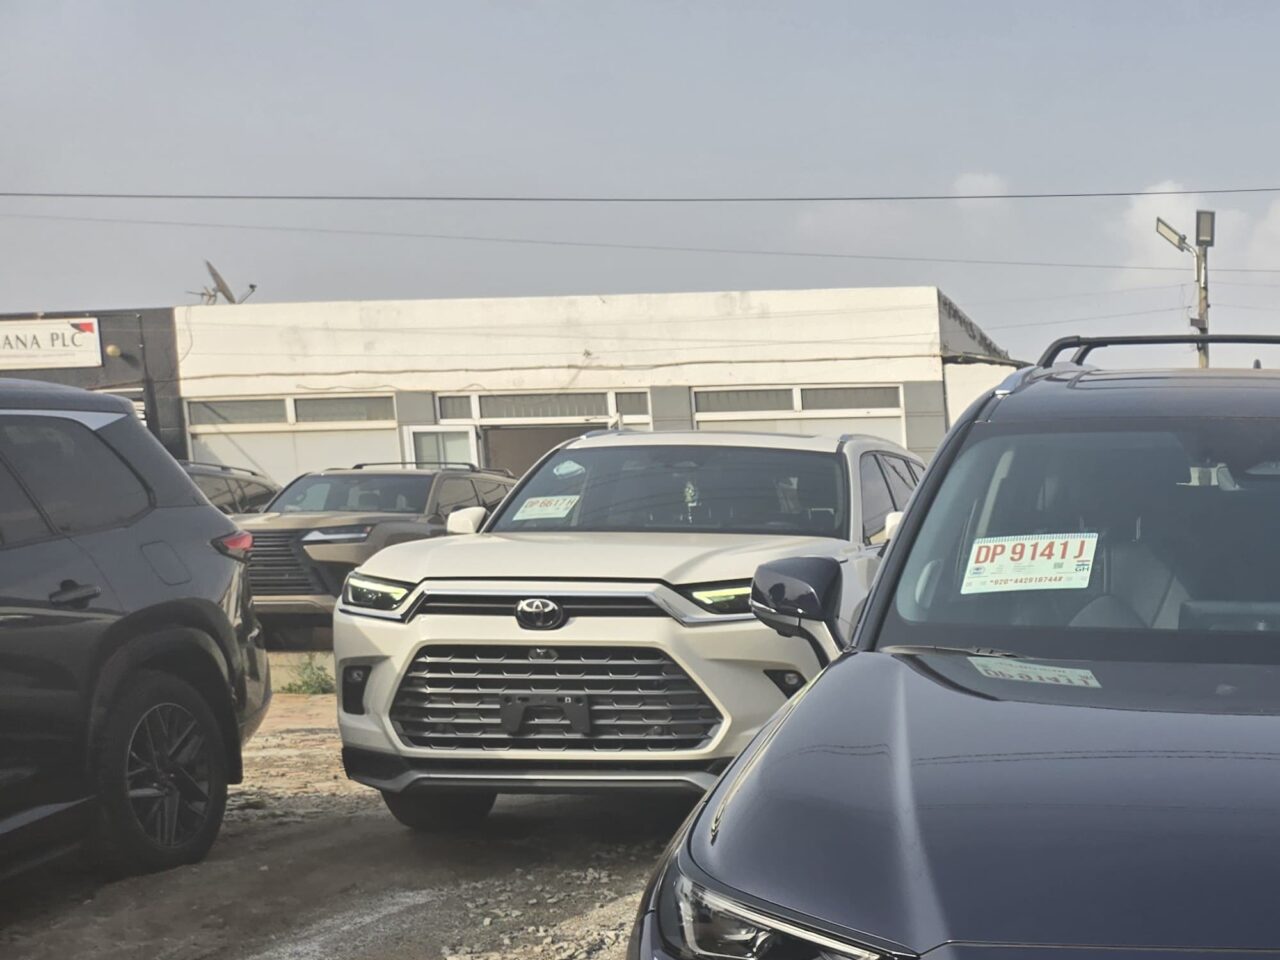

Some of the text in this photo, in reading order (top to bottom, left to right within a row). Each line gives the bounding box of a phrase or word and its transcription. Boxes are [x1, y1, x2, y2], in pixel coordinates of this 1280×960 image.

[50, 332, 84, 348] PLC
[974, 540, 1086, 564] DP 9141 J
